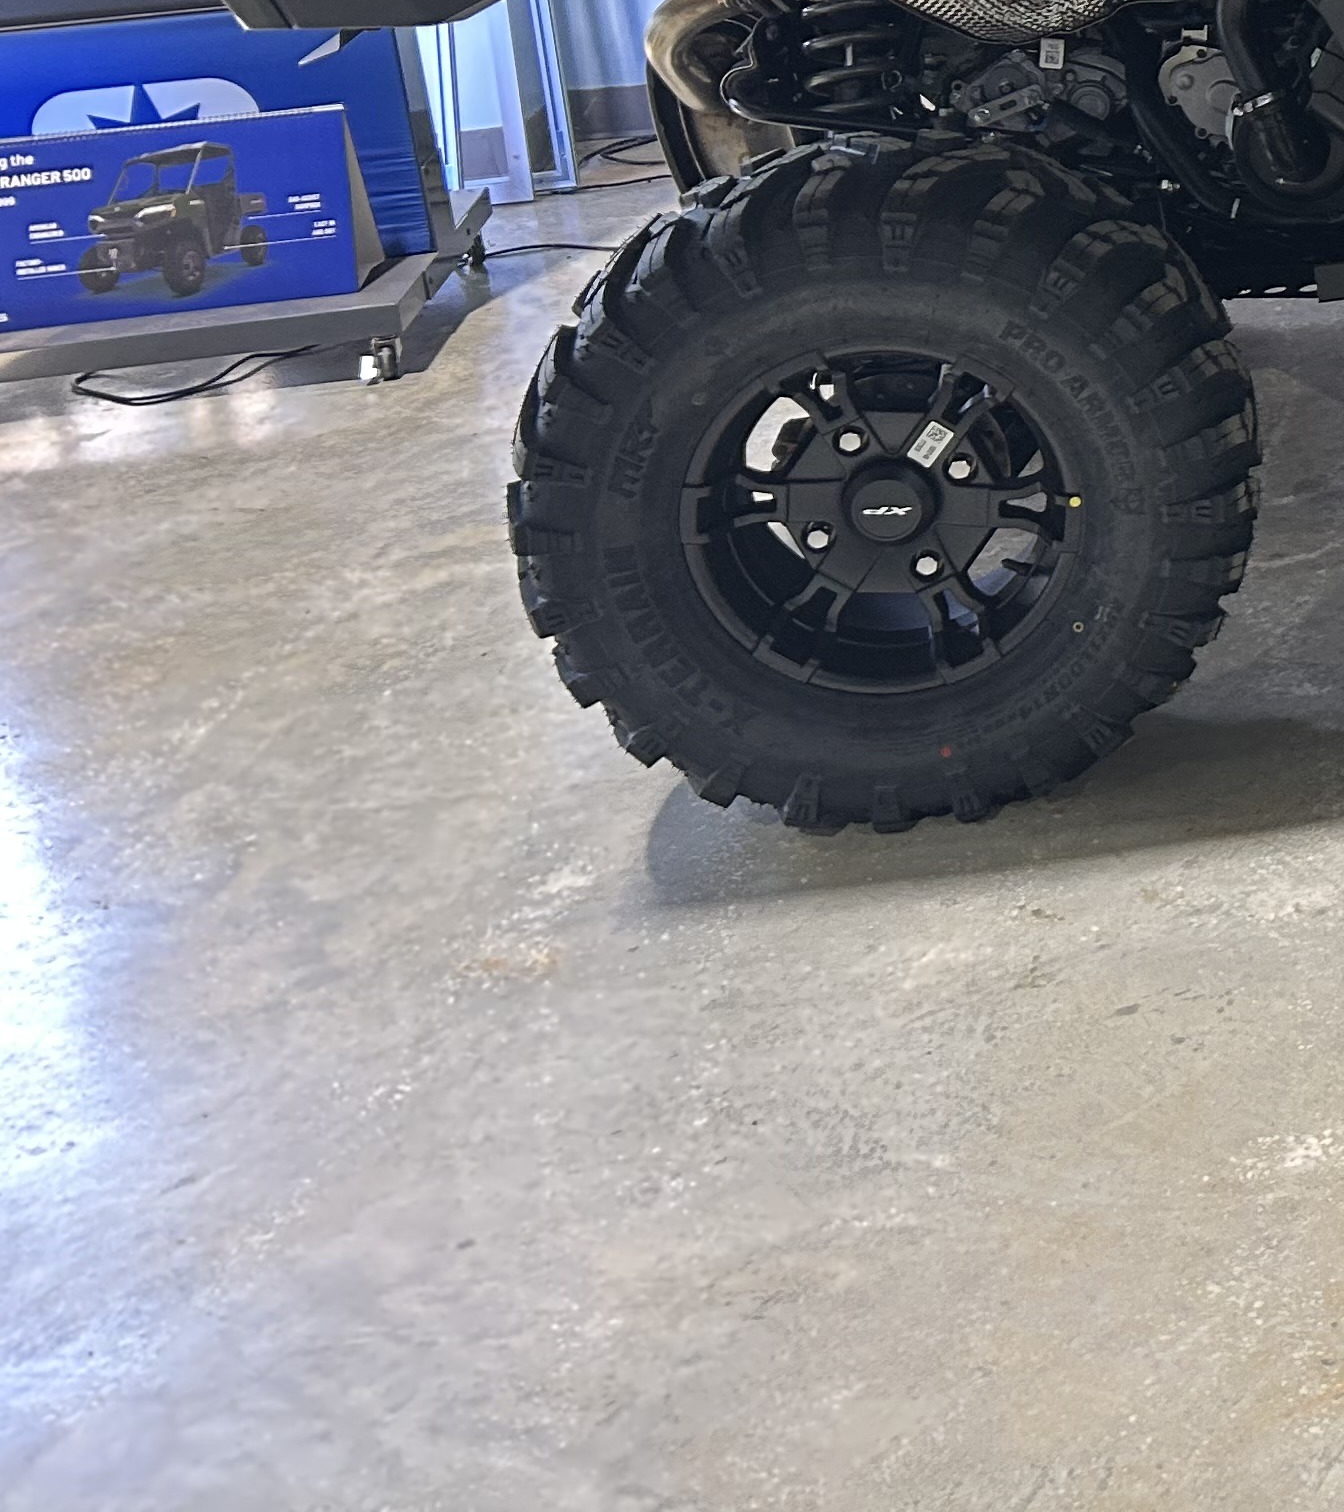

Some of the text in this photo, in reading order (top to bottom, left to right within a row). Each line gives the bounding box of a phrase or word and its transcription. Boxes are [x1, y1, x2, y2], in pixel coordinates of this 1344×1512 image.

[10, 154, 34, 166] the
[0, 167, 92, 188] RANGER 500
[862, 505, 913, 518] XP
